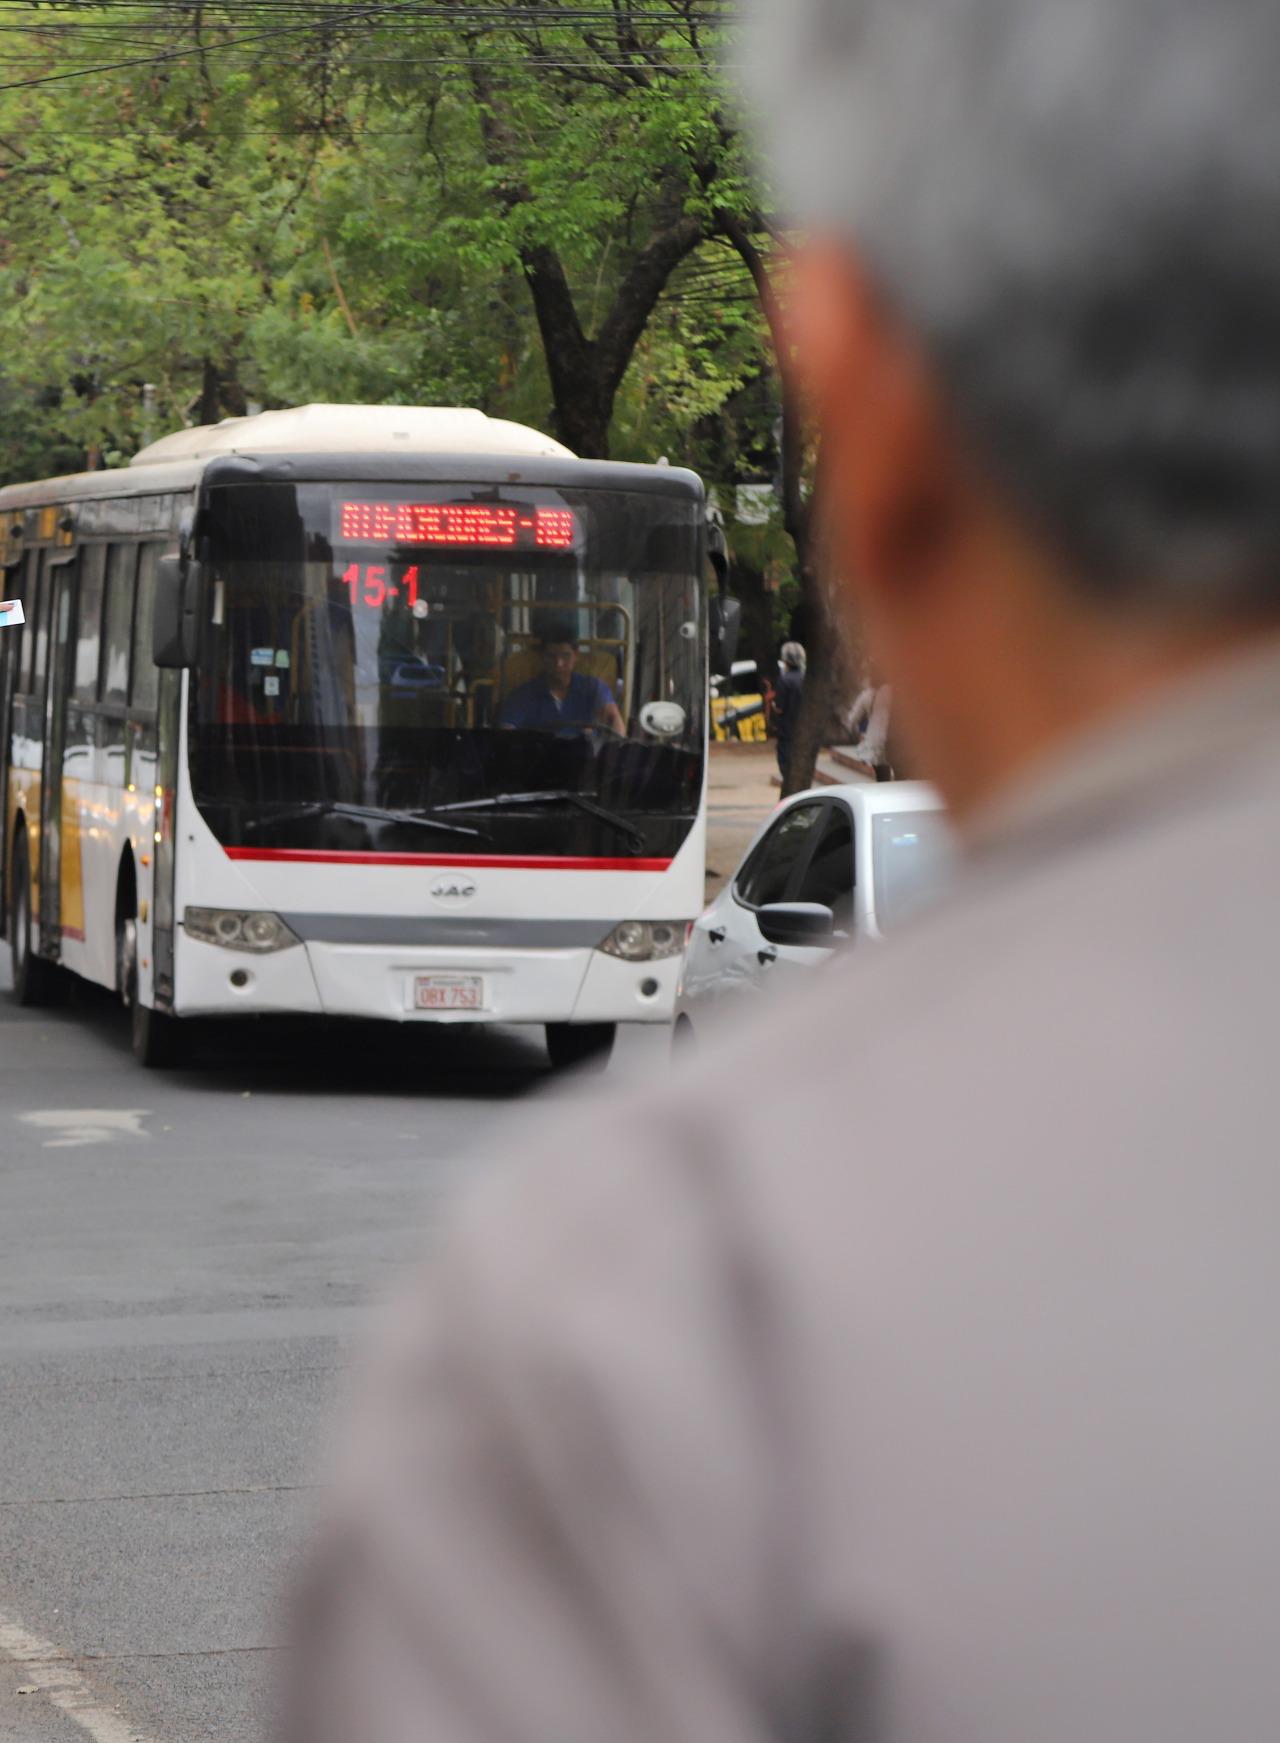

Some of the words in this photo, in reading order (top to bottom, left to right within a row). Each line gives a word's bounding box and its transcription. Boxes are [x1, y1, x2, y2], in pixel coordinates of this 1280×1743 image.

[342, 562, 419, 608] 15-1
[431, 885, 476, 897] JAC
[450, 987, 477, 1008] 753
